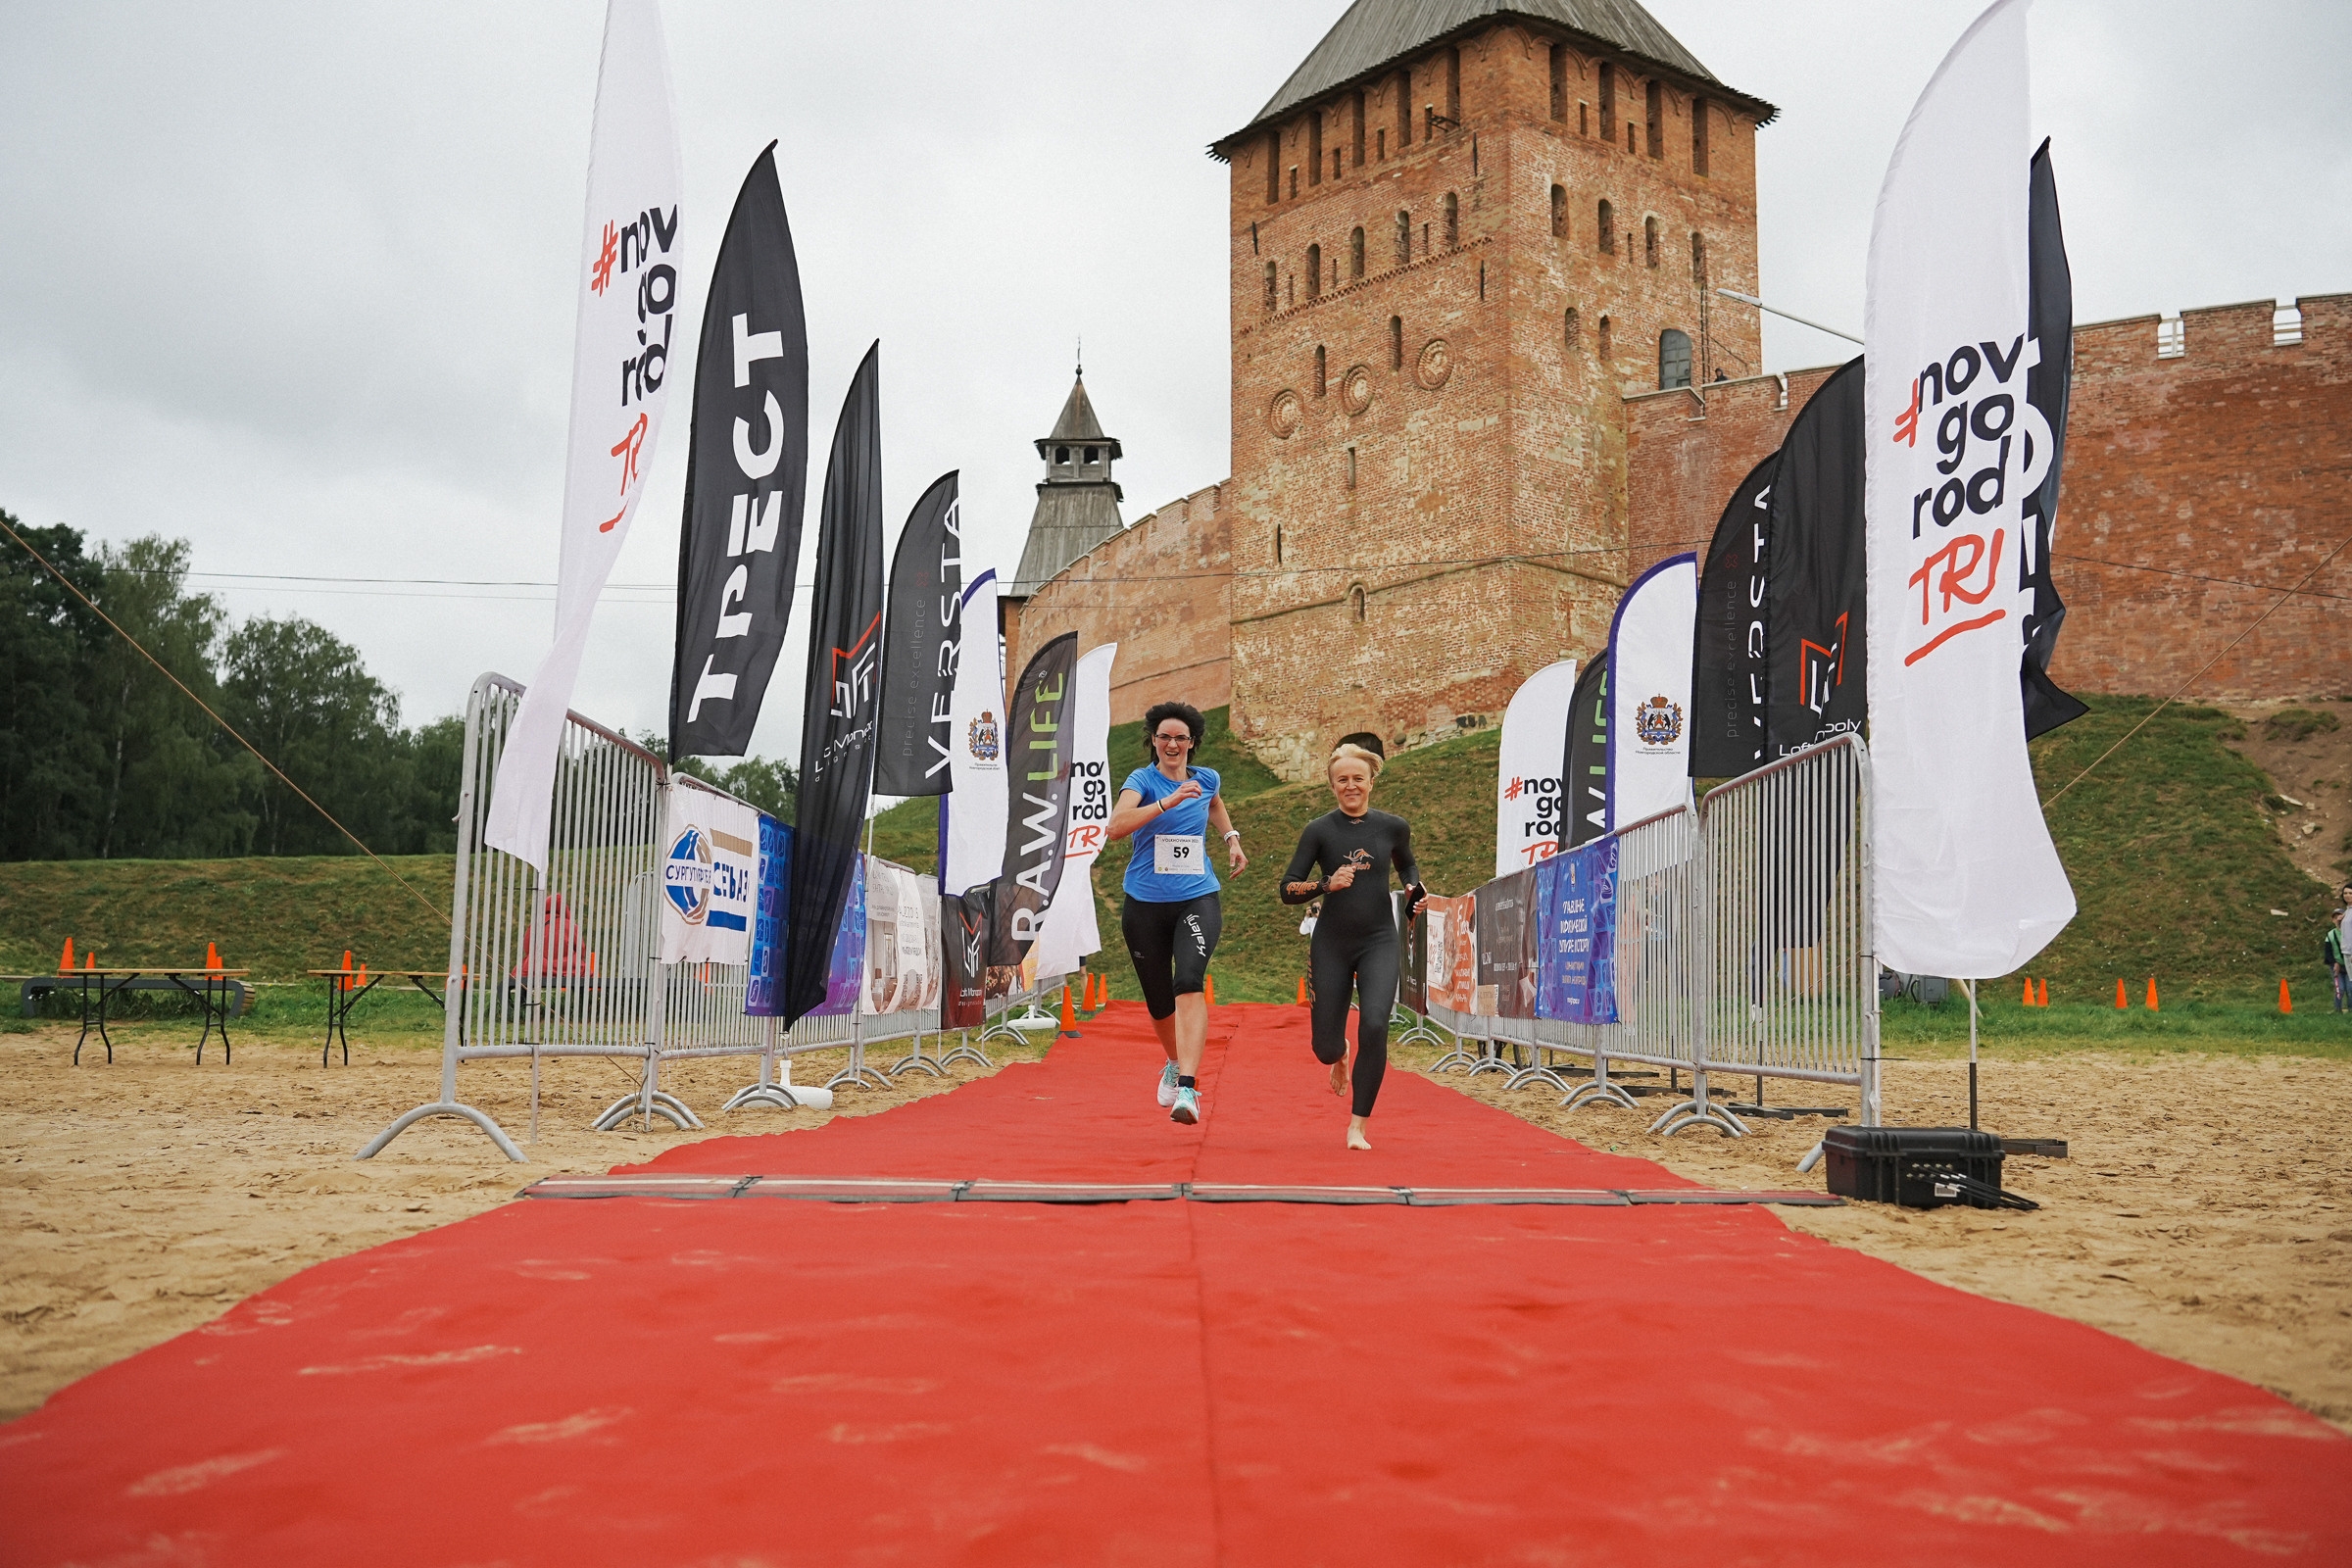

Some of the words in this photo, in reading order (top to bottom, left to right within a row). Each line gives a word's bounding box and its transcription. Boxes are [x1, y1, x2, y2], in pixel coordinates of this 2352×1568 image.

[1892, 332, 2025, 449] #nov
[1936, 393, 2015, 475] go
[1912, 434, 2012, 541] rod
[1908, 527, 2005, 626] TRI
[908, 598, 926, 689] excellence
[902, 695, 917, 758] precise
[1072, 795, 1107, 820] rod
[1173, 846, 1190, 858] 59
